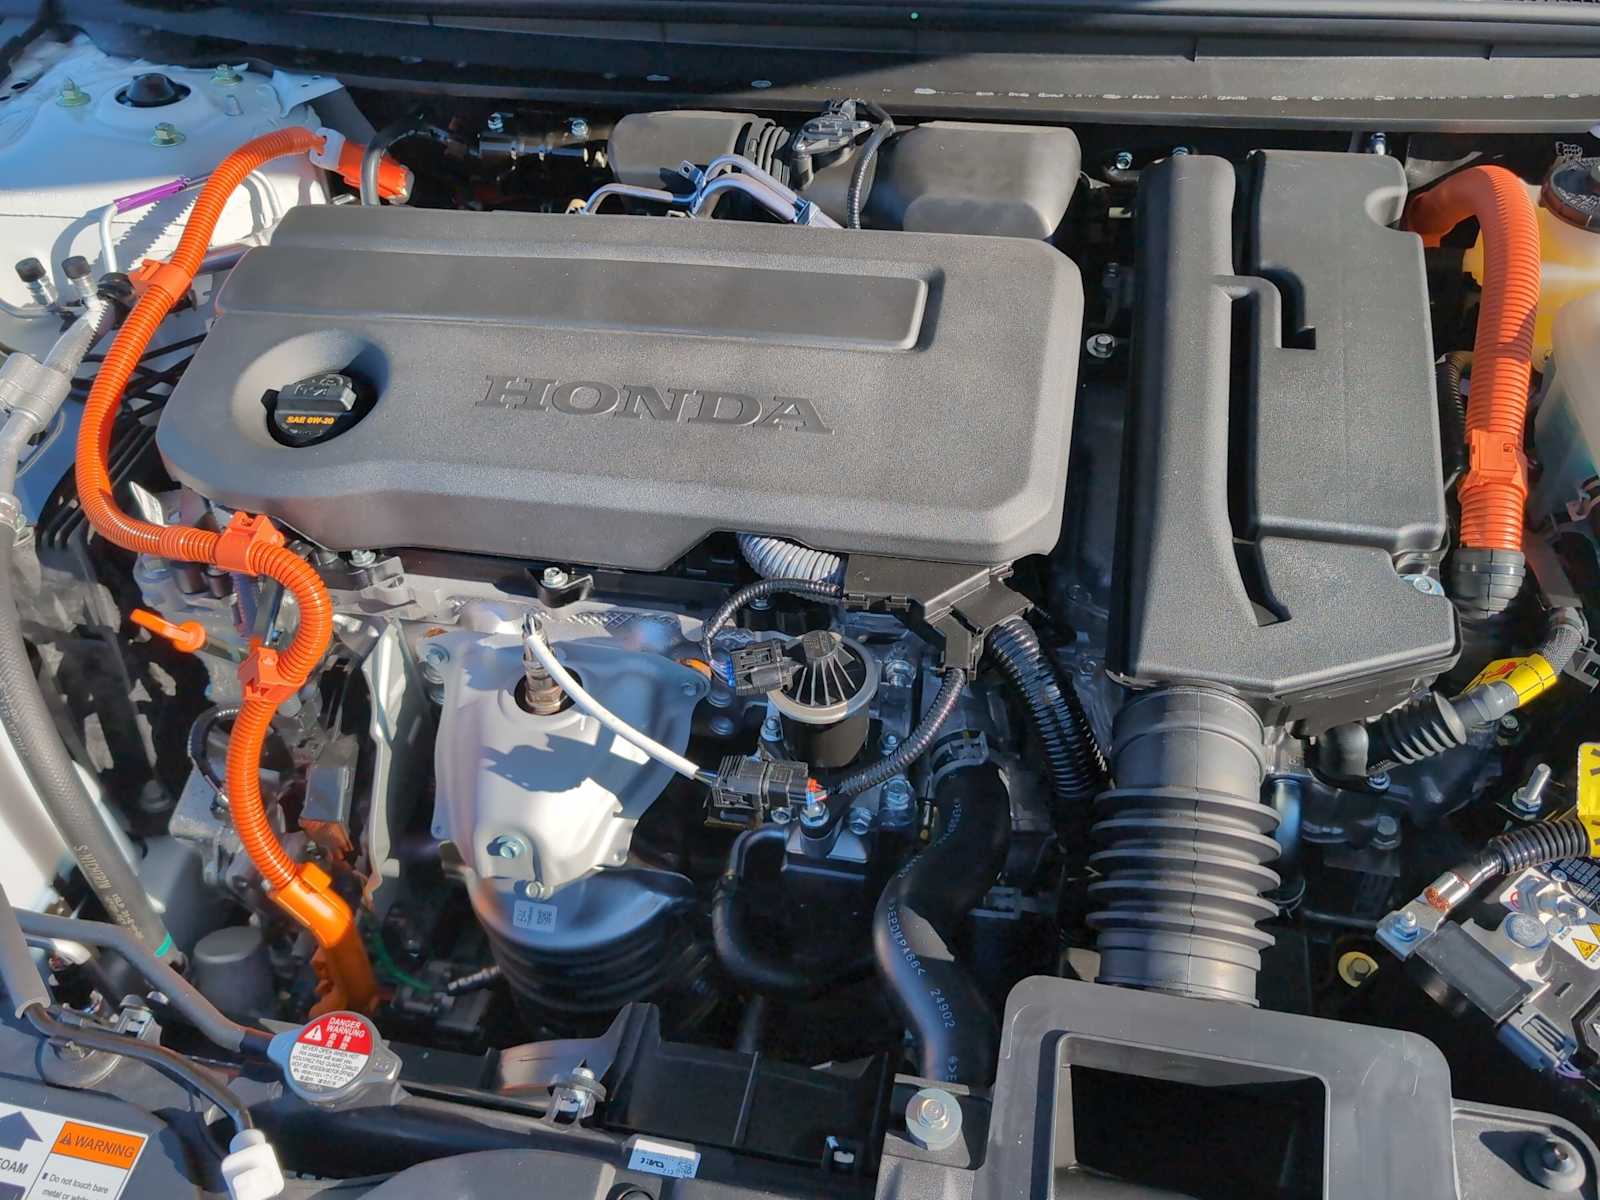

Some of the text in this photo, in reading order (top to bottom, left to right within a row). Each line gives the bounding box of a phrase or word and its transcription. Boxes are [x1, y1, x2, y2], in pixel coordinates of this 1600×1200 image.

[475, 375, 835, 435] HONDA
[329, 1016, 361, 1030] DANGER
[75, 1135, 136, 1158] WARNING
[0, 1157, 28, 1174] OAM
[49, 1173, 110, 1194] Do not touch bare
